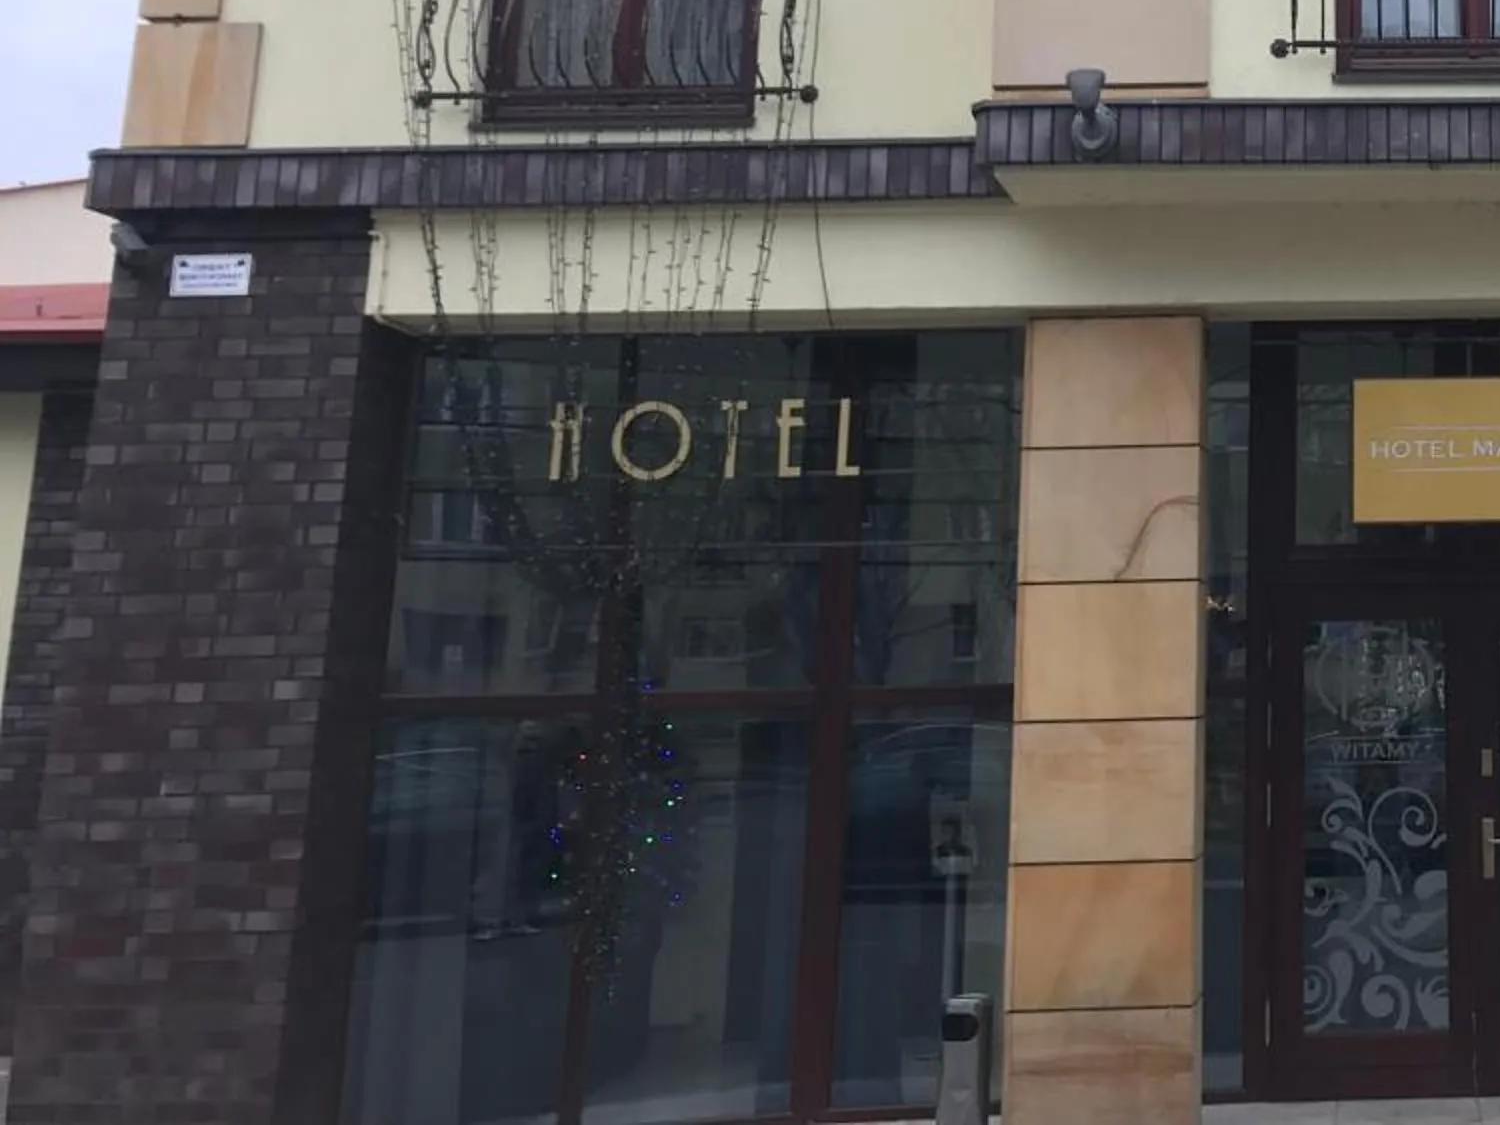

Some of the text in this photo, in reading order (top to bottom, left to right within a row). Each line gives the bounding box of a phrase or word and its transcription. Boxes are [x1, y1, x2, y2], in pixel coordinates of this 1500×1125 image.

[549, 398, 861, 481] HOTEL
[1371, 439, 1466, 459] HOTEL
[1331, 742, 1419, 760] WITAMY
